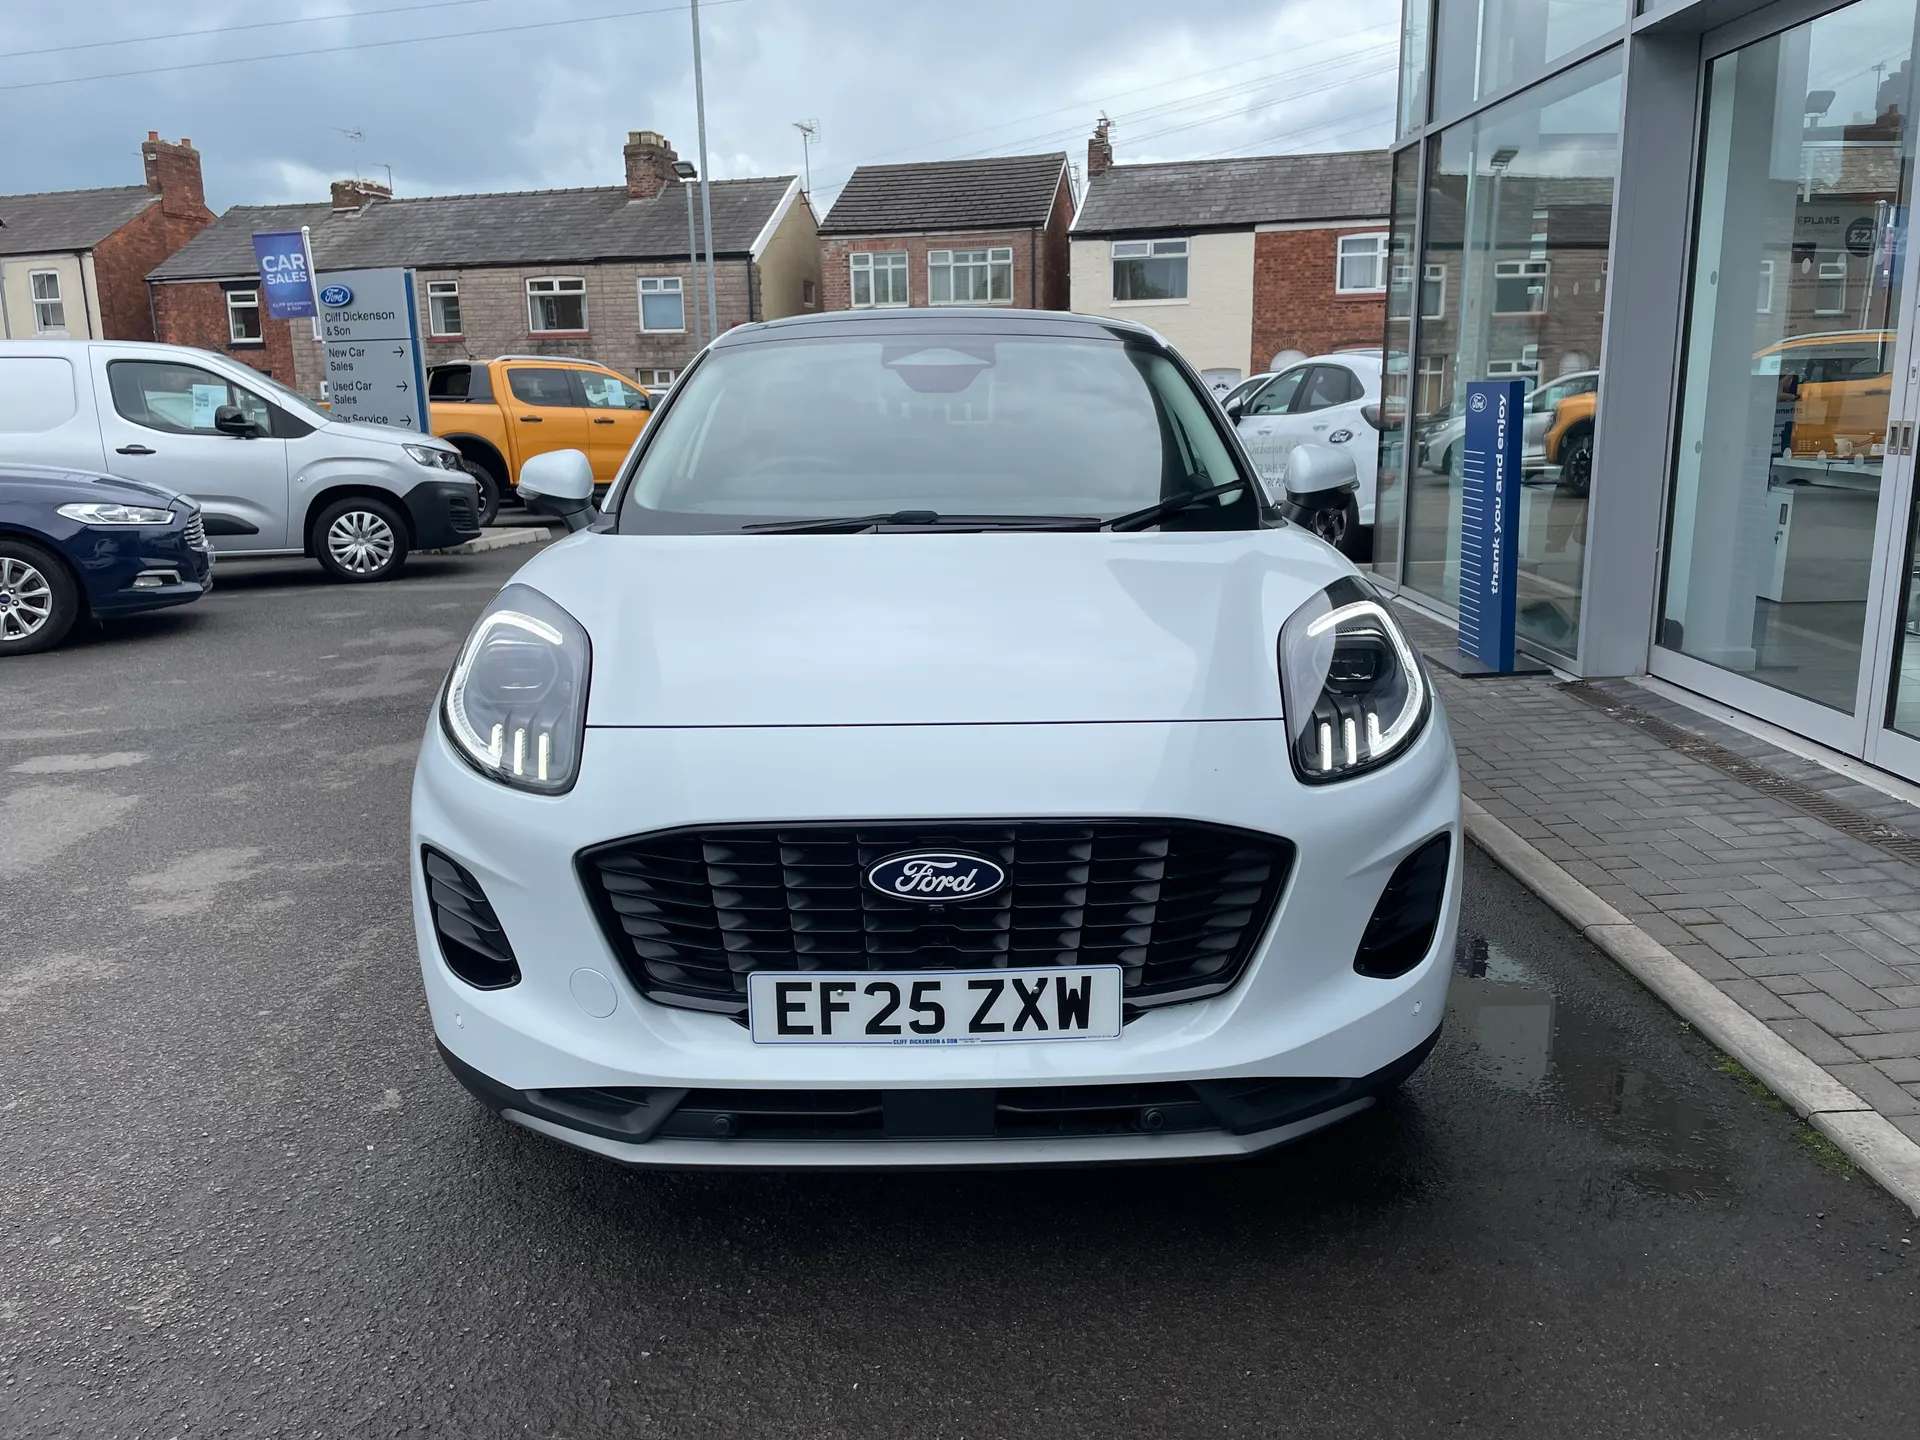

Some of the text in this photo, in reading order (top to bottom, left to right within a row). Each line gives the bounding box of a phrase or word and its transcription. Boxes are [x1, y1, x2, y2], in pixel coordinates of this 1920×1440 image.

[262, 253, 305, 272] CAR
[266, 271, 307, 285] SALES
[325, 288, 344, 302] Ford
[325, 311, 395, 323] Cliff Dickenson
[326, 326, 351, 336] & Son
[329, 347, 365, 358] New Car
[330, 361, 354, 371] Sales
[332, 381, 372, 391] Used Car
[334, 394, 357, 405] Sales
[352, 413, 388, 424] Service
[1491, 394, 1506, 594] thank you and enjoy
[894, 860, 978, 892] Ford
[775, 975, 1092, 1036] EF25 ZXW
